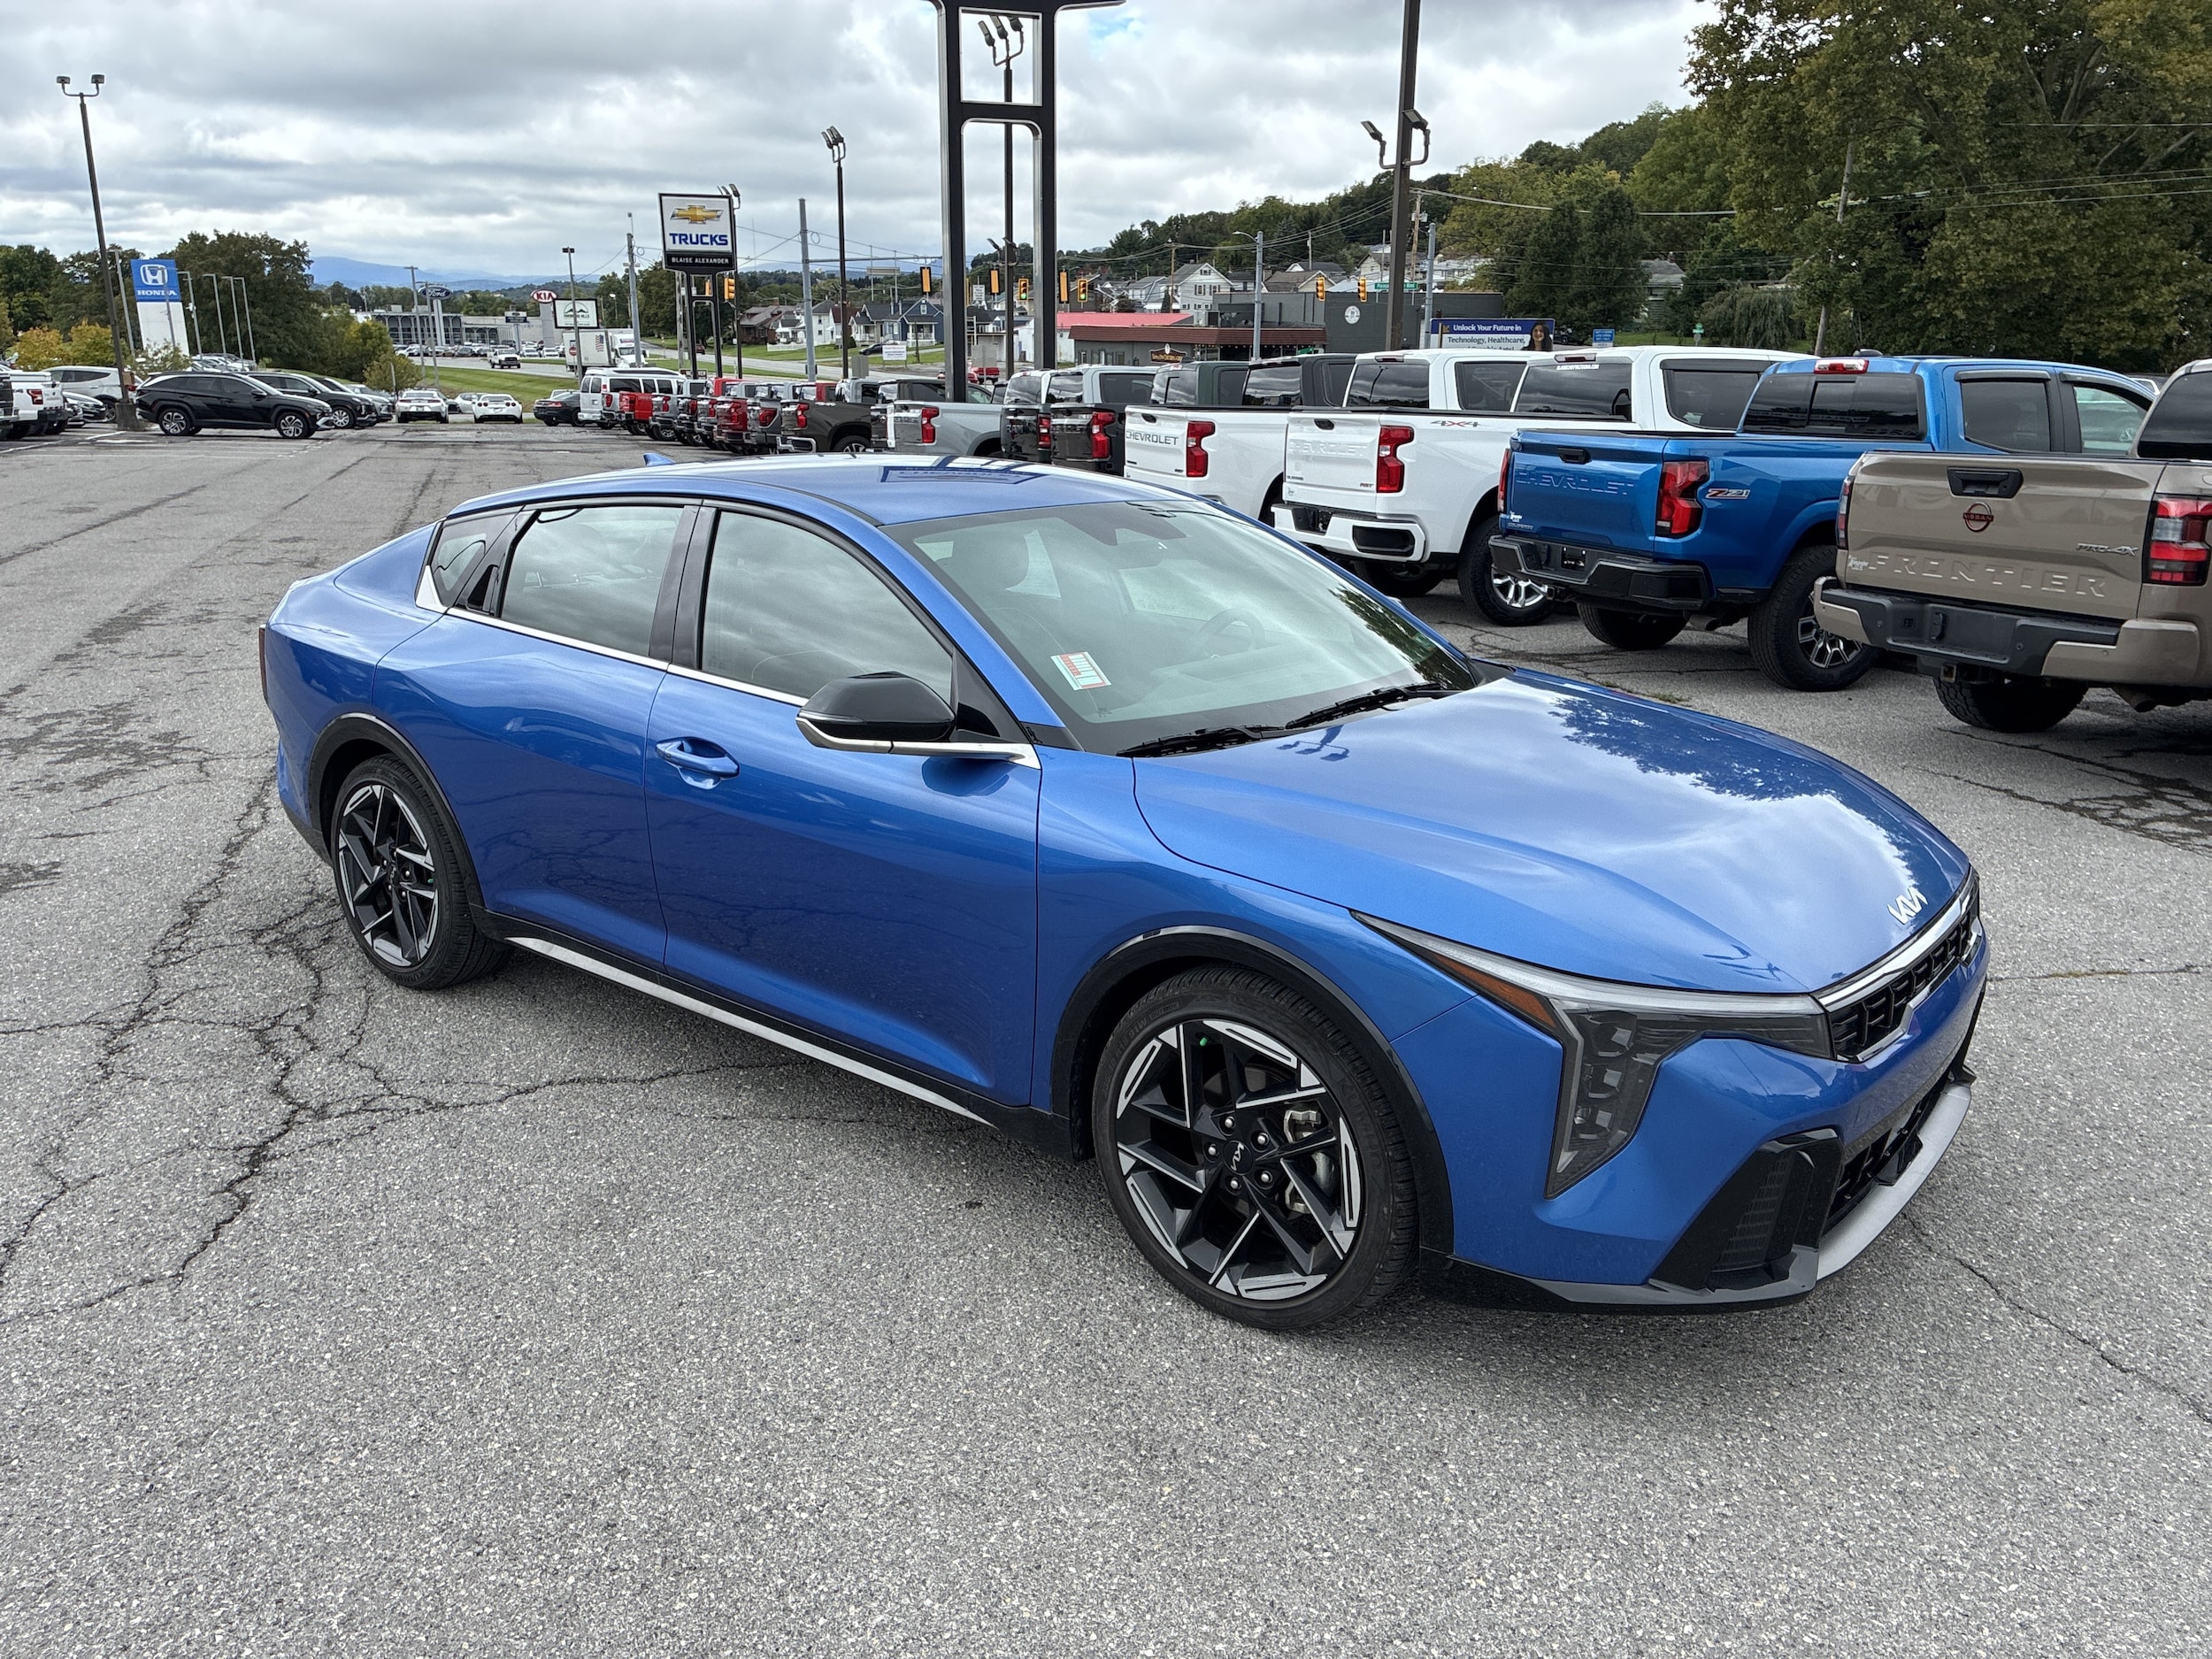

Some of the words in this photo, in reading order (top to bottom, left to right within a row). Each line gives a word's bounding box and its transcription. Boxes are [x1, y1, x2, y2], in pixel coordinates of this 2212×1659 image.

[669, 233, 728, 246] TRUCKS
[427, 288, 446, 297] Ford
[1448, 336, 1486, 345] Technology,
[1125, 430, 1179, 445] CHEVROLET
[1287, 440, 1368, 457] CHEVROLET
[1516, 471, 1635, 496] CHEVROLET
[2076, 542, 2139, 557] PRO-4X
[1868, 551, 2107, 598] FRONTIER
